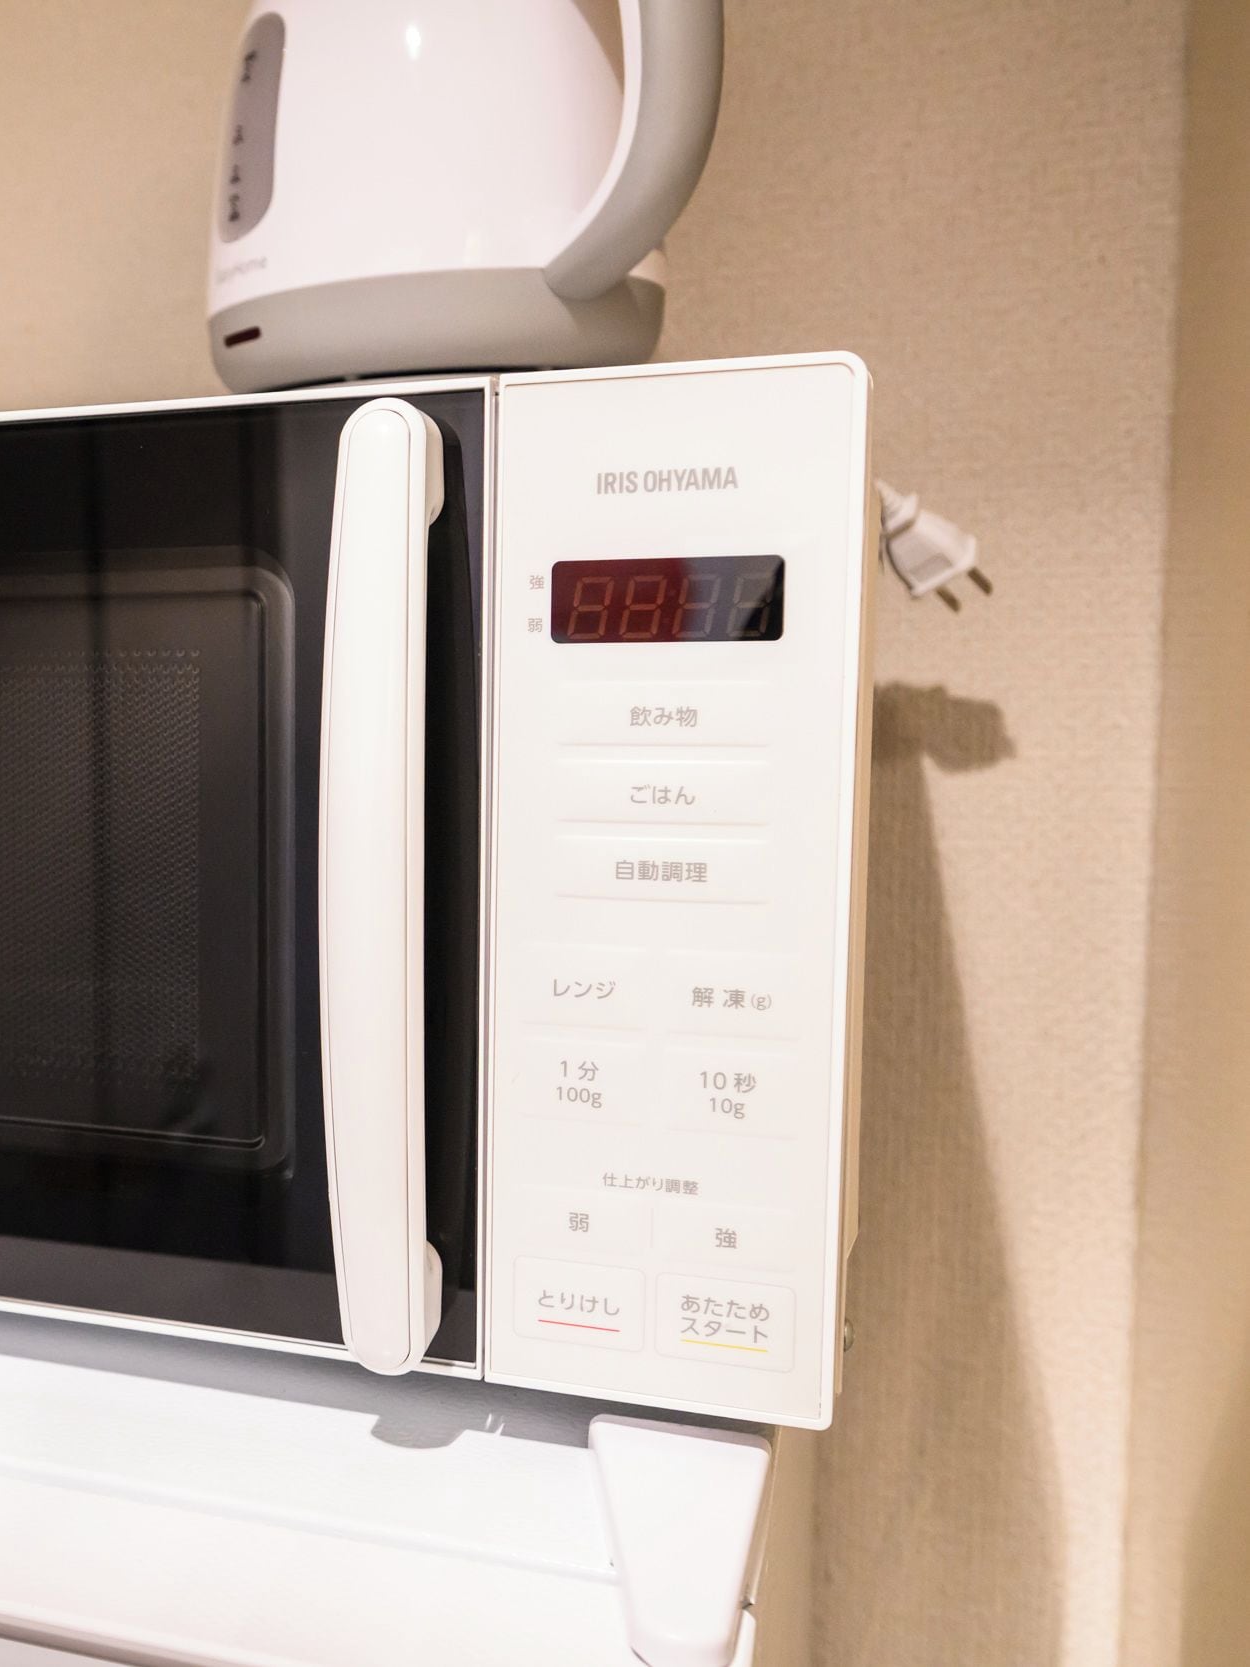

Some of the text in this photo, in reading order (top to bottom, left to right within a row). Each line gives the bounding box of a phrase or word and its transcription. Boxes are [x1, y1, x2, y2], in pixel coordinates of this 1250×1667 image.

[597, 467, 738, 495] IRIS OHYAMA
[529, 575, 544, 590] 強
[528, 618, 542, 632] 弱
[630, 706, 698, 727] 飲み物
[630, 784, 695, 805] ごはん
[615, 860, 707, 882] 自動調理
[554, 979, 616, 999] レンジ
[557, 1086, 602, 1108] 100g
[710, 1098, 745, 1119] 10g
[603, 1173, 699, 1195] 仕上がり調整
[569, 1212, 589, 1232] 弱
[715, 1228, 737, 1249] 強
[538, 1290, 619, 1316] とりけし
[680, 1294, 771, 1322] あたため
[679, 1316, 770, 1344] スタート
